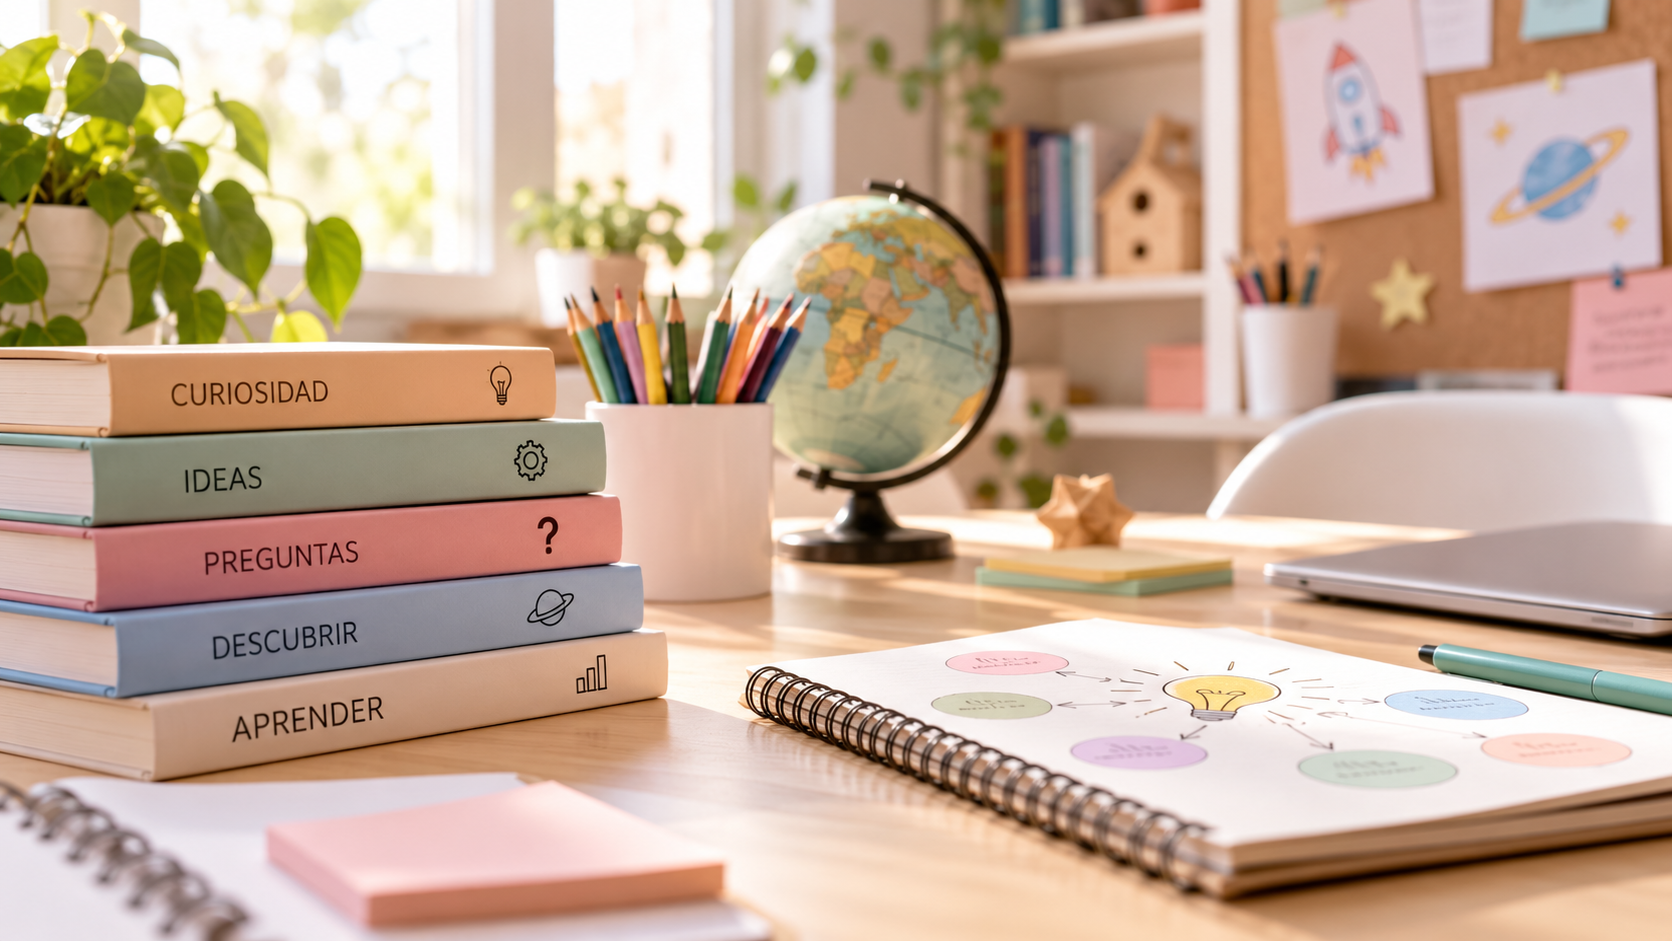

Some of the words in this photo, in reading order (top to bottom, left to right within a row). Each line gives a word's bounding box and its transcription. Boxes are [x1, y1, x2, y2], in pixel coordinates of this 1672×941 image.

[171, 380, 329, 407] CURIOSIDAD
[184, 465, 263, 494] IDEAS
[204, 541, 359, 576] PREGUNTAS
[212, 621, 359, 661] DESCUBRIR
[232, 696, 384, 743] APRENDER
